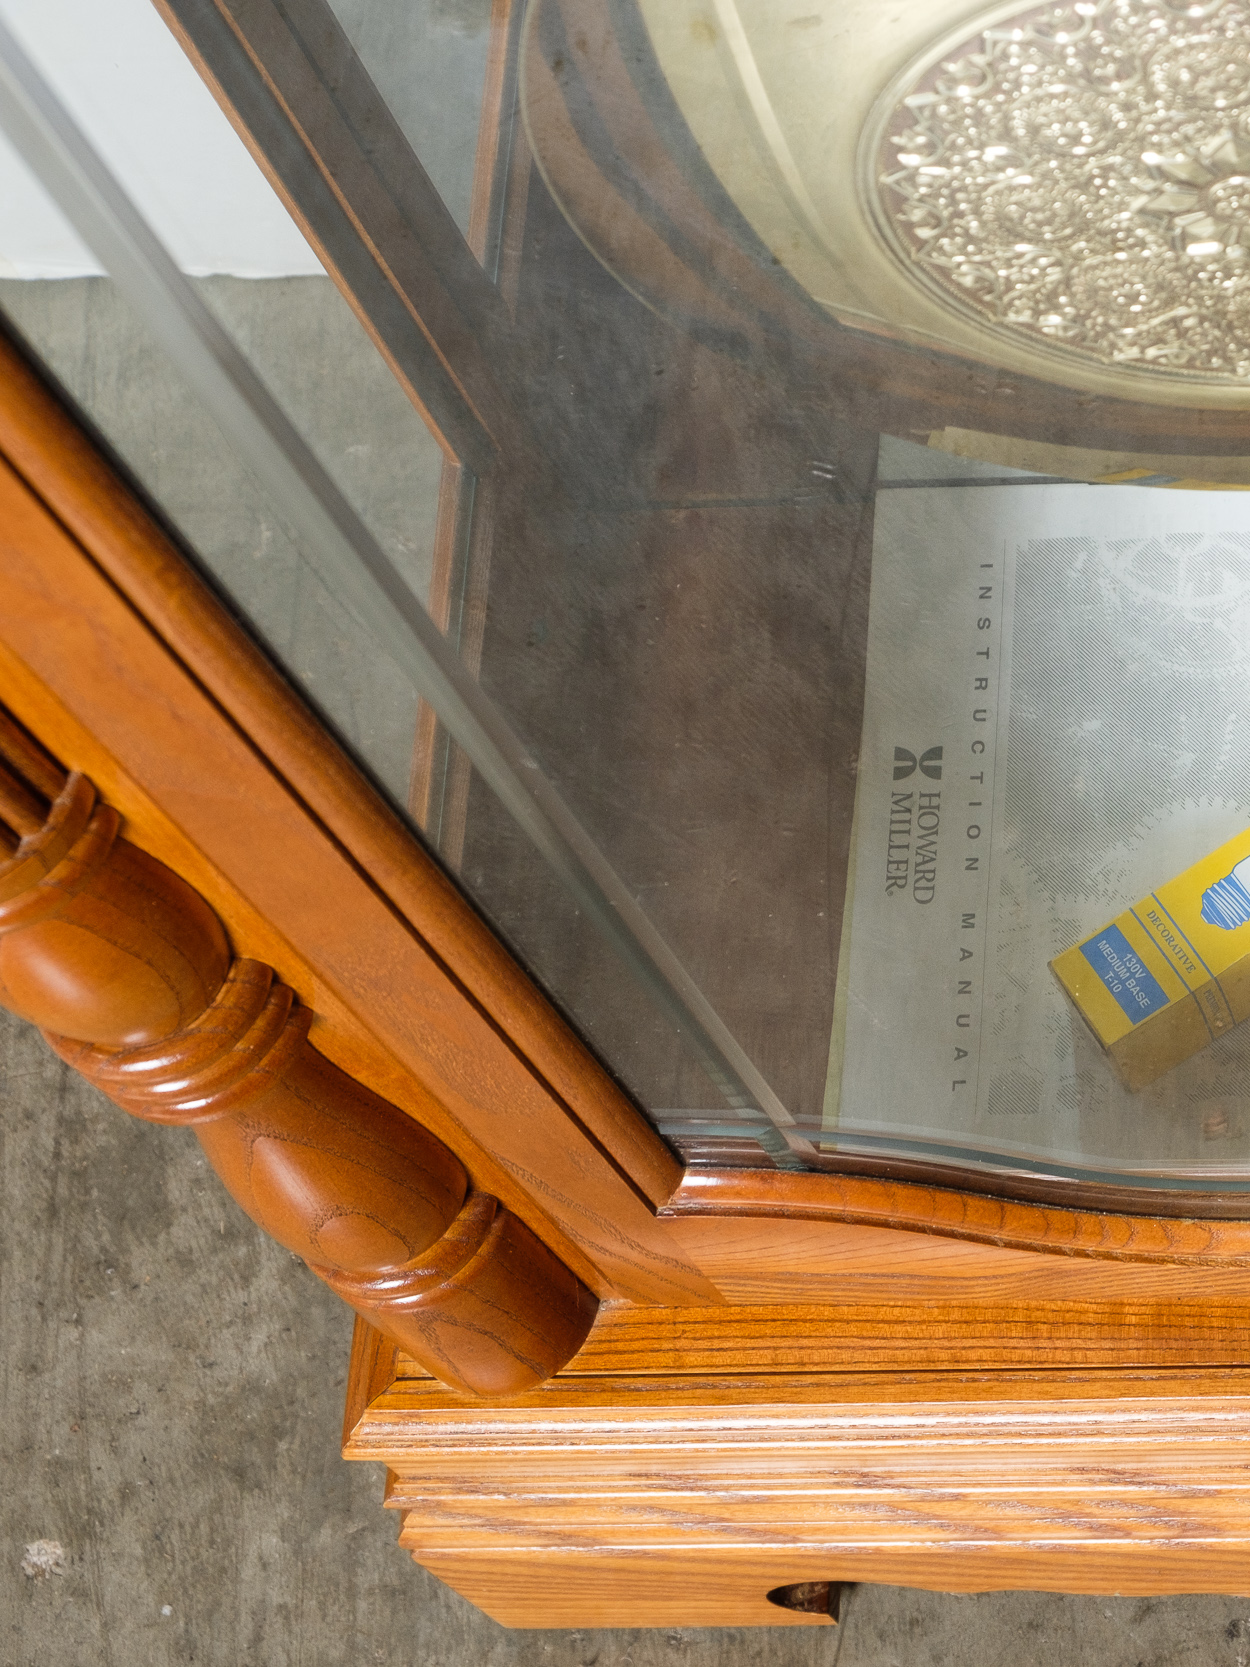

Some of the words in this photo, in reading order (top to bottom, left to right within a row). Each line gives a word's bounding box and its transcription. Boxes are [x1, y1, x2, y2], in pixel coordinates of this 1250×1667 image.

[965, 563, 994, 872] INSTRUCTION
[912, 790, 941, 905] HOWARD
[1097, 939, 1130, 980] MEDIUM
[1125, 978, 1151, 1009] BASE
[1123, 953, 1147, 978] 130V
[1146, 910, 1197, 974] DECORATIVE
[951, 912, 976, 1092] MANUAL
[1104, 971, 1123, 993] T-10
